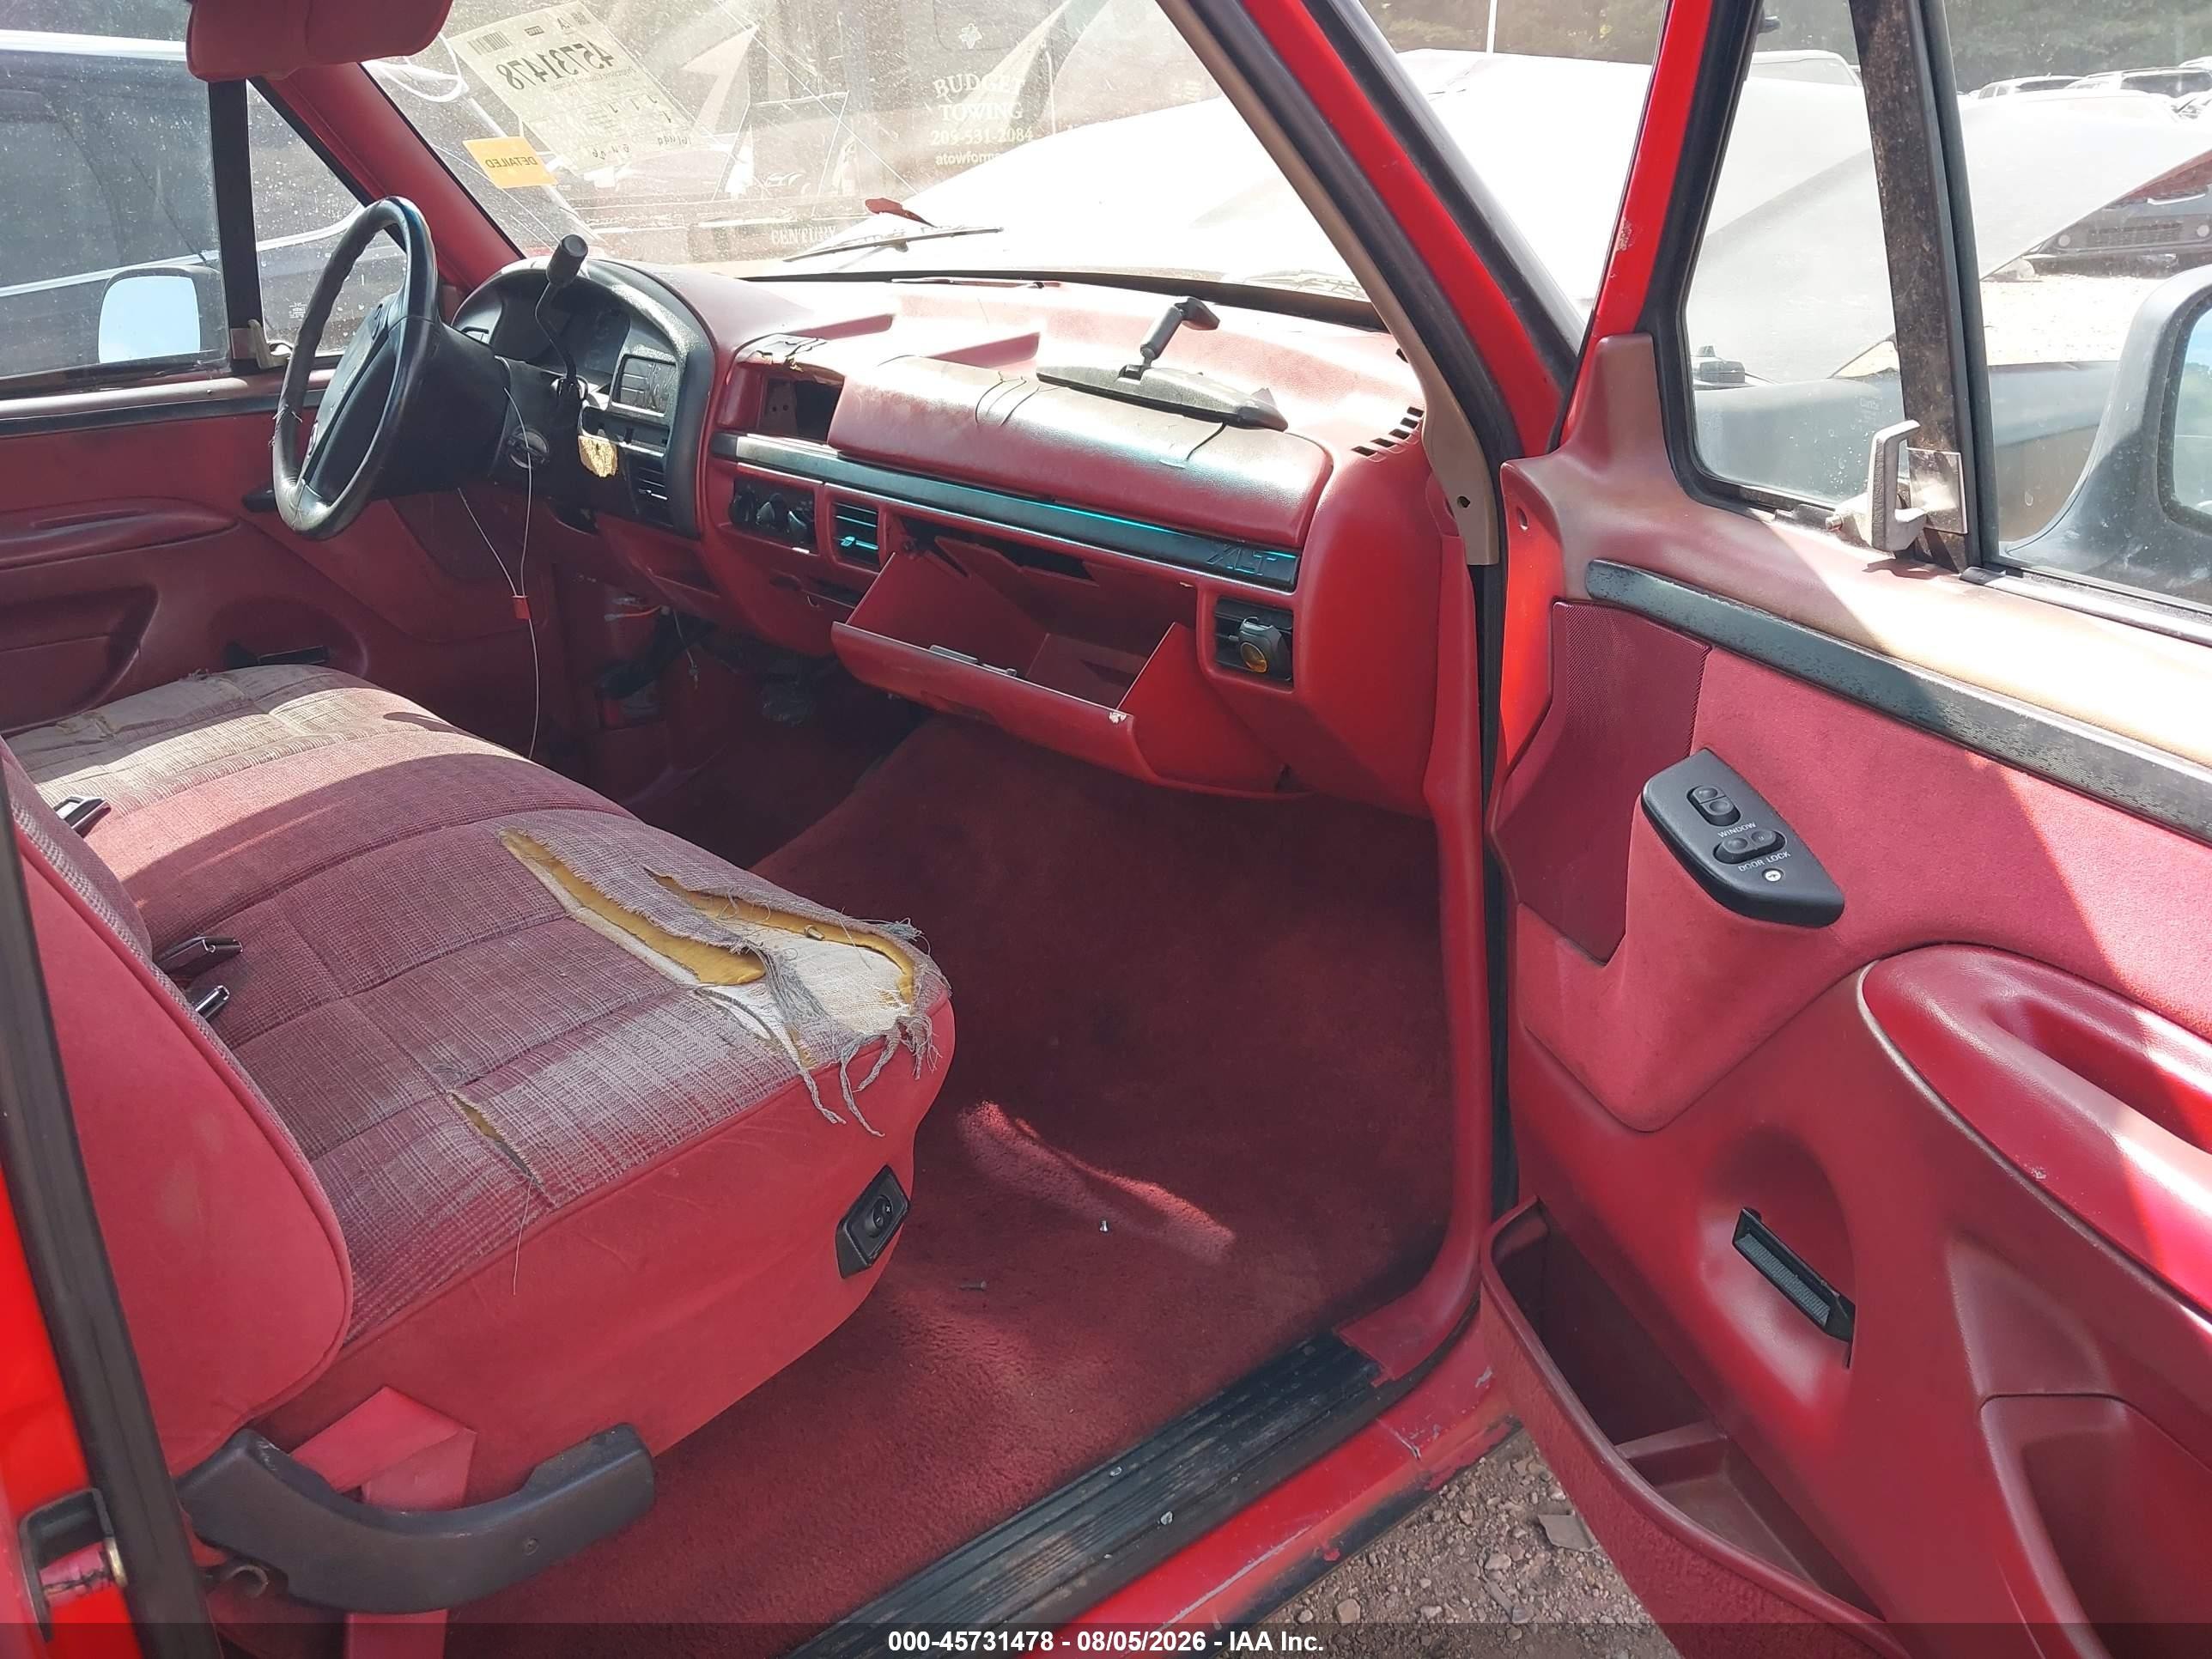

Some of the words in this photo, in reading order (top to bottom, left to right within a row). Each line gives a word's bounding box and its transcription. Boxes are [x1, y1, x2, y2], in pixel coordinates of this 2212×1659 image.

[933, 73, 1024, 98] BUDGET
[939, 101, 1024, 121] TOWING
[1206, 544, 1278, 576] XLT
[1717, 821, 1757, 839] WINDOW
[1737, 859, 1765, 872] DOOR
[1765, 850, 1792, 864] LOCK
